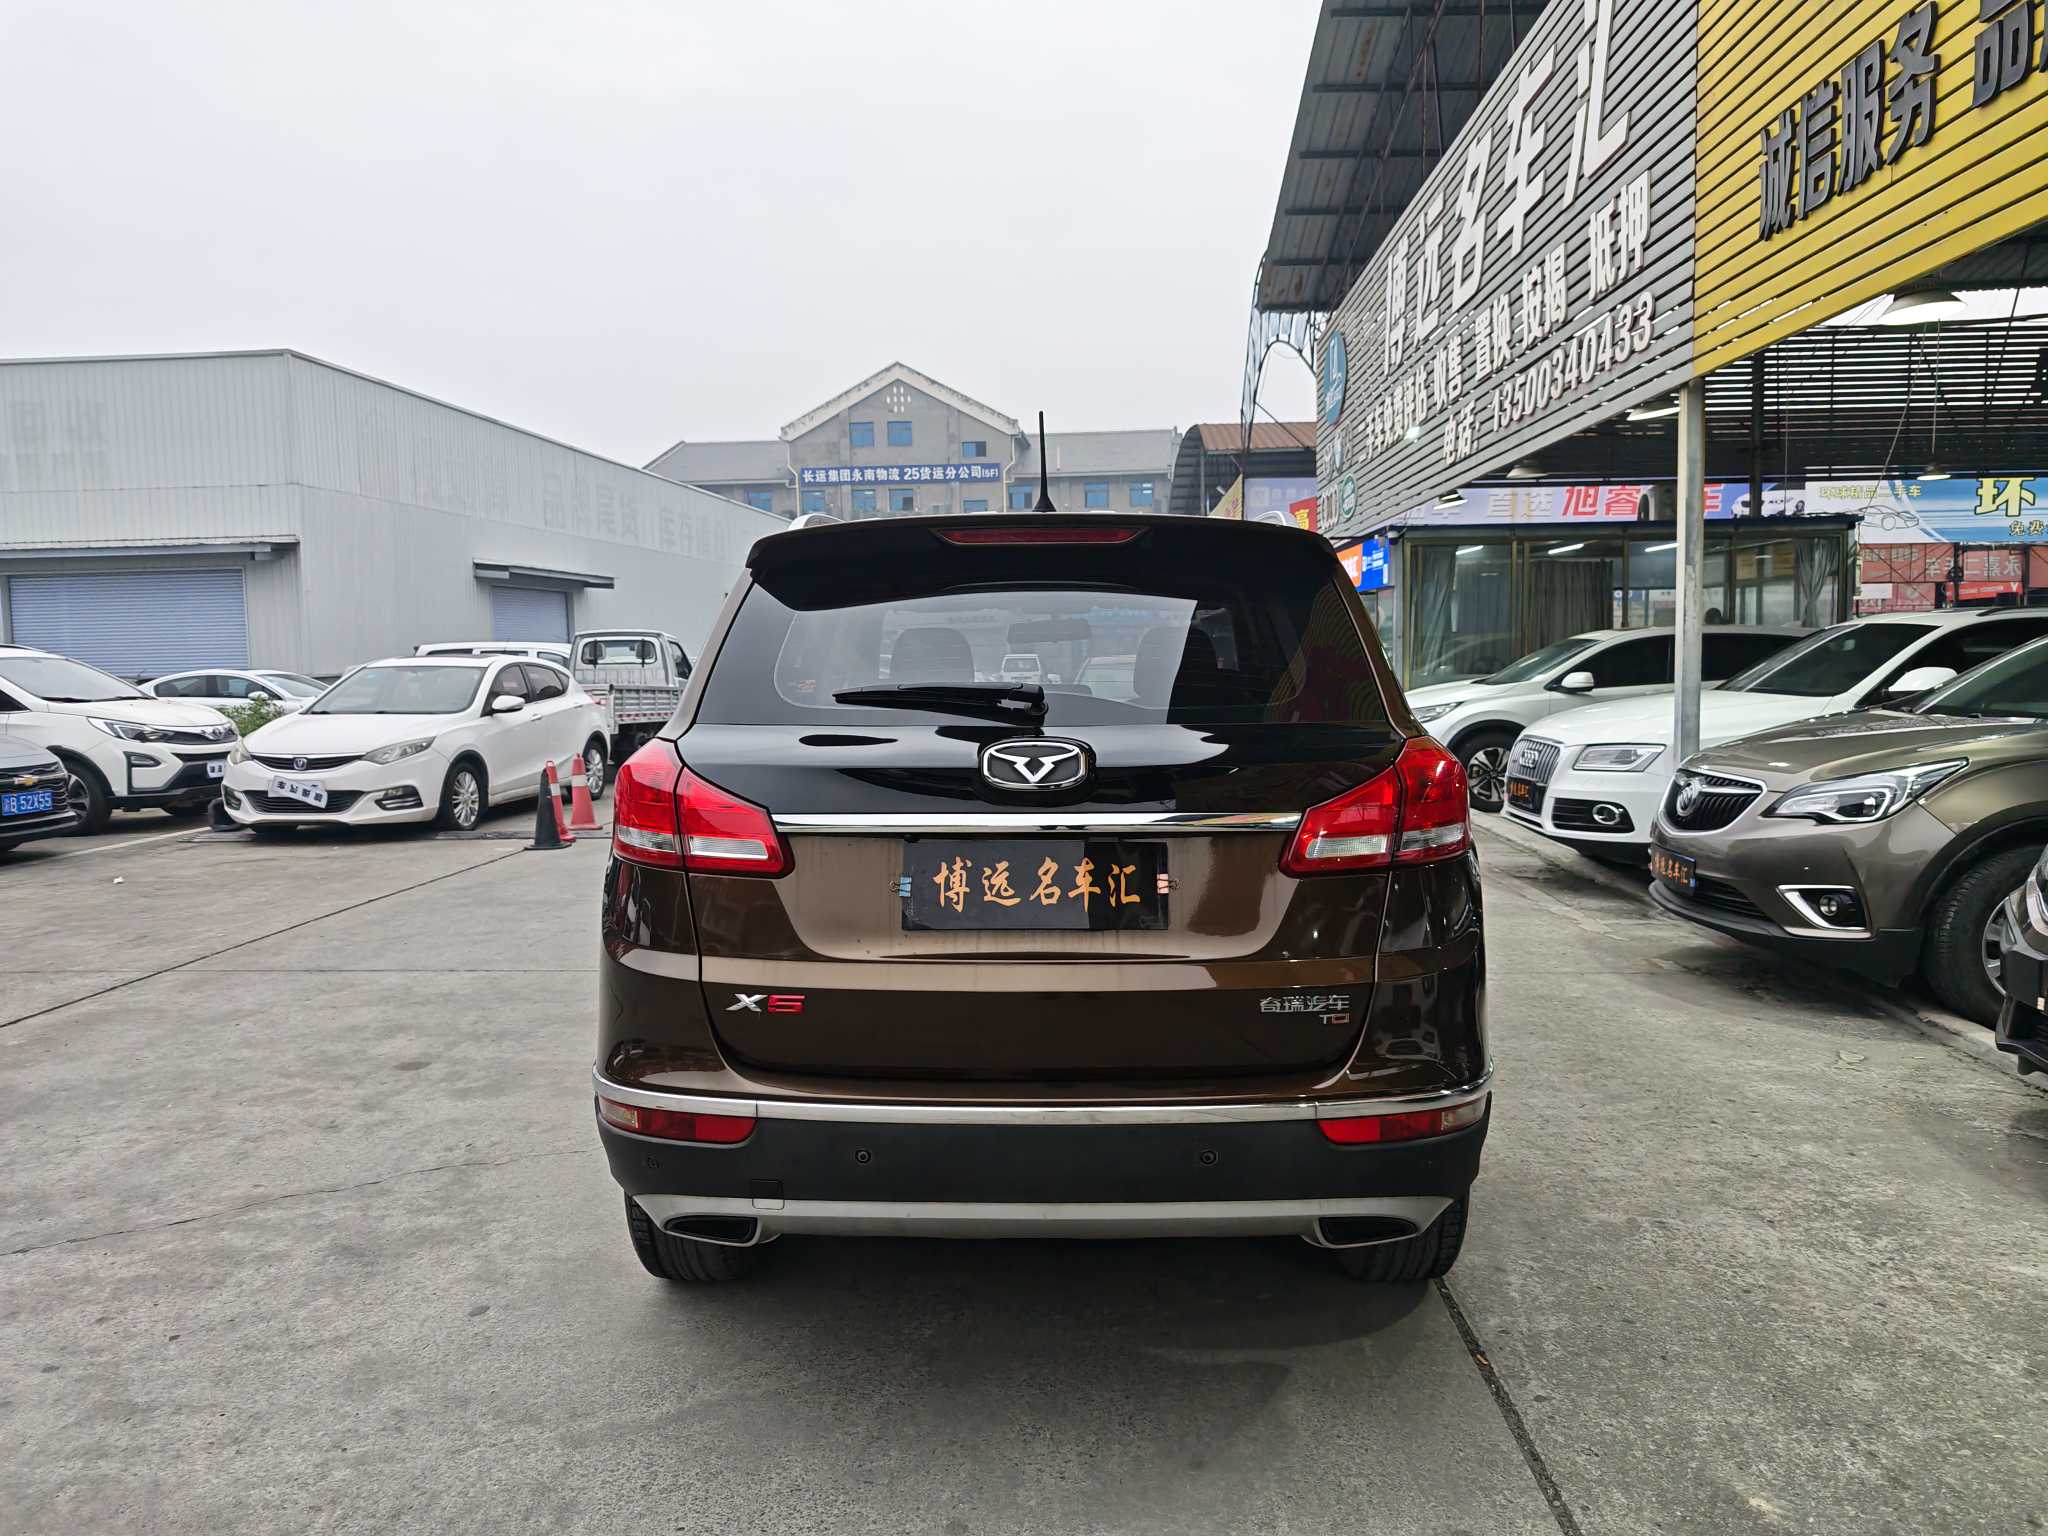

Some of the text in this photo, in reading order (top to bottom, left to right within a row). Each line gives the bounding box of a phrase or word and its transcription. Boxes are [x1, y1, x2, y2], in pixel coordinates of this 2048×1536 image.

[1384, 0, 1631, 376] 博远名车汇
[1759, 0, 2048, 240] 诚信服务 品
[1433, 335, 1463, 412] 收售
[1475, 293, 1512, 382] 置换
[1521, 241, 1568, 352] 按揭
[1589, 169, 1650, 301] 抵押
[1491, 291, 1656, 432] 13500340433
[932, 855, 1141, 913] 博远名车汇
[725, 993, 805, 1013] X5
[1260, 994, 1350, 1013] 奇瑞汽车
